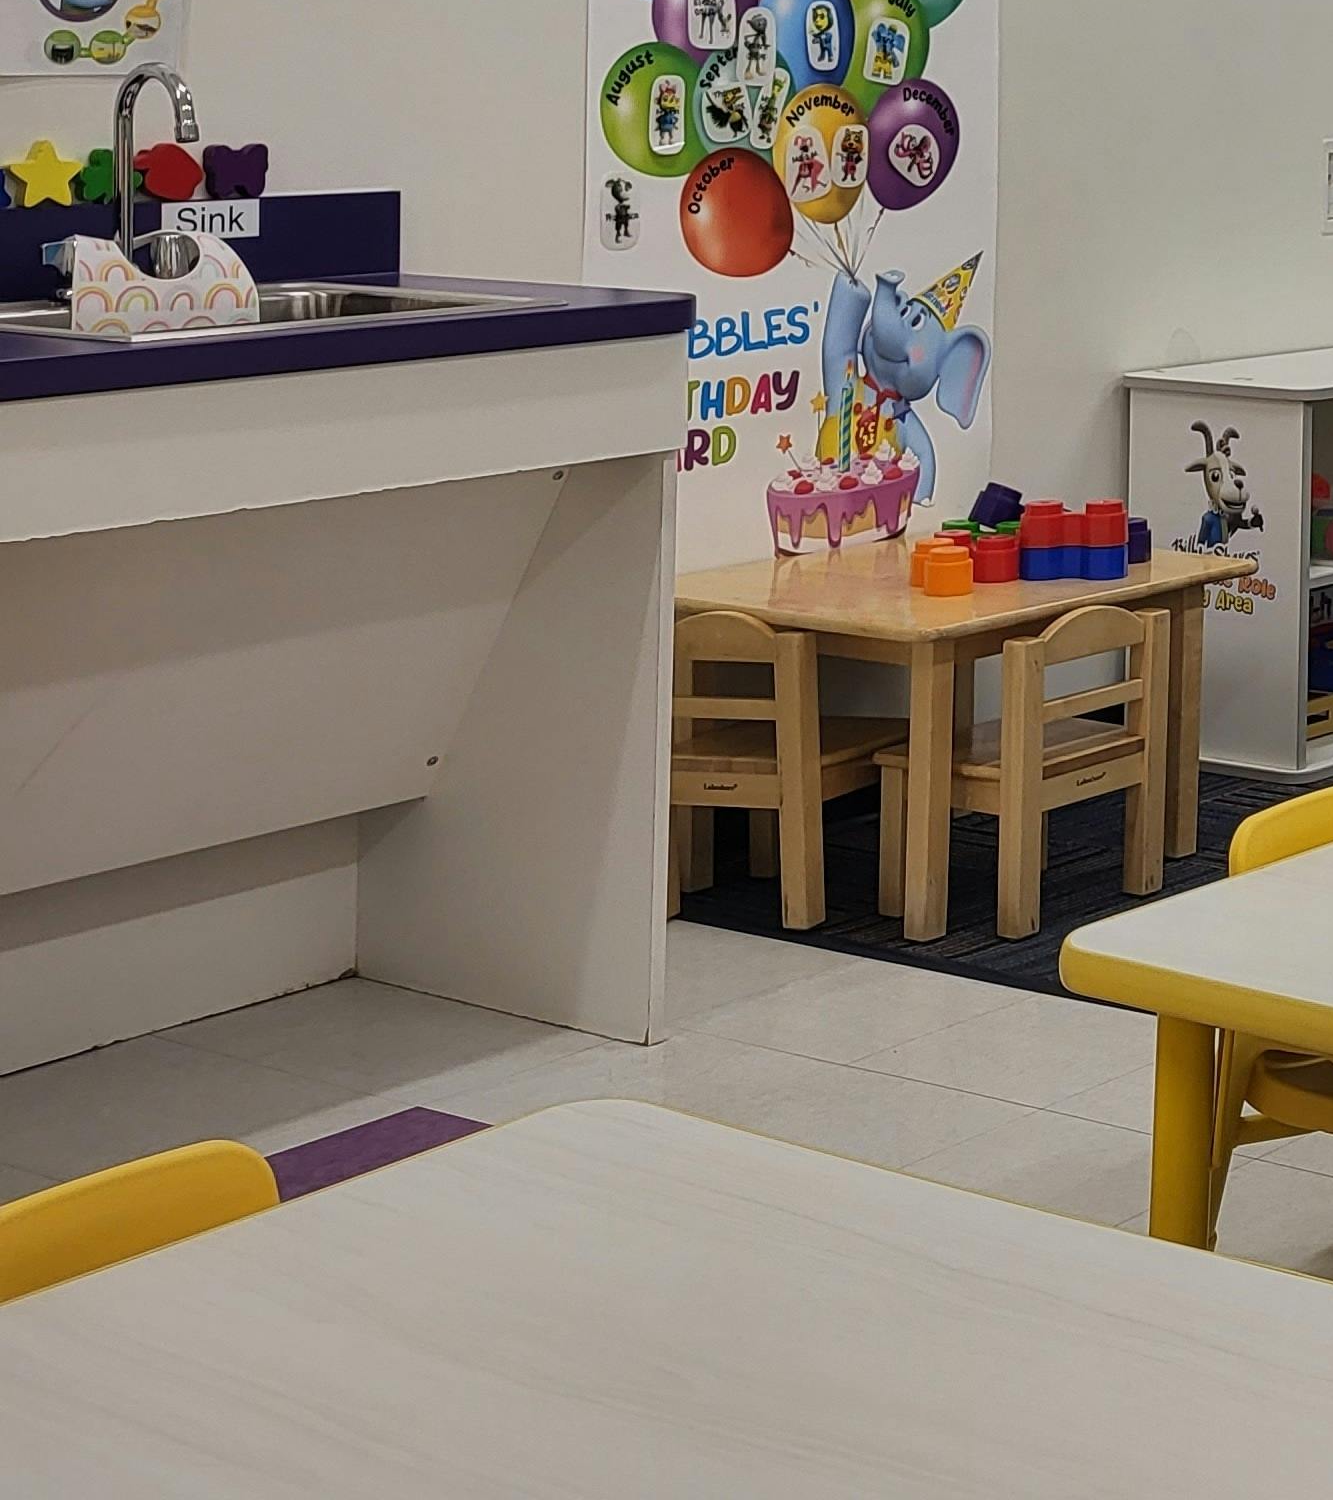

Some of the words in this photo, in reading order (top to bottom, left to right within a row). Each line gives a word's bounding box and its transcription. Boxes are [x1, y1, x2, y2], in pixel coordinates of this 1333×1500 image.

[605, 50, 655, 106] August
[785, 95, 855, 127] November
[903, 87, 955, 136] December
[688, 156, 735, 215] October
[176, 205, 245, 233] Sink
[1215, 590, 1254, 615] Area
[1238, 577, 1276, 600] Role
